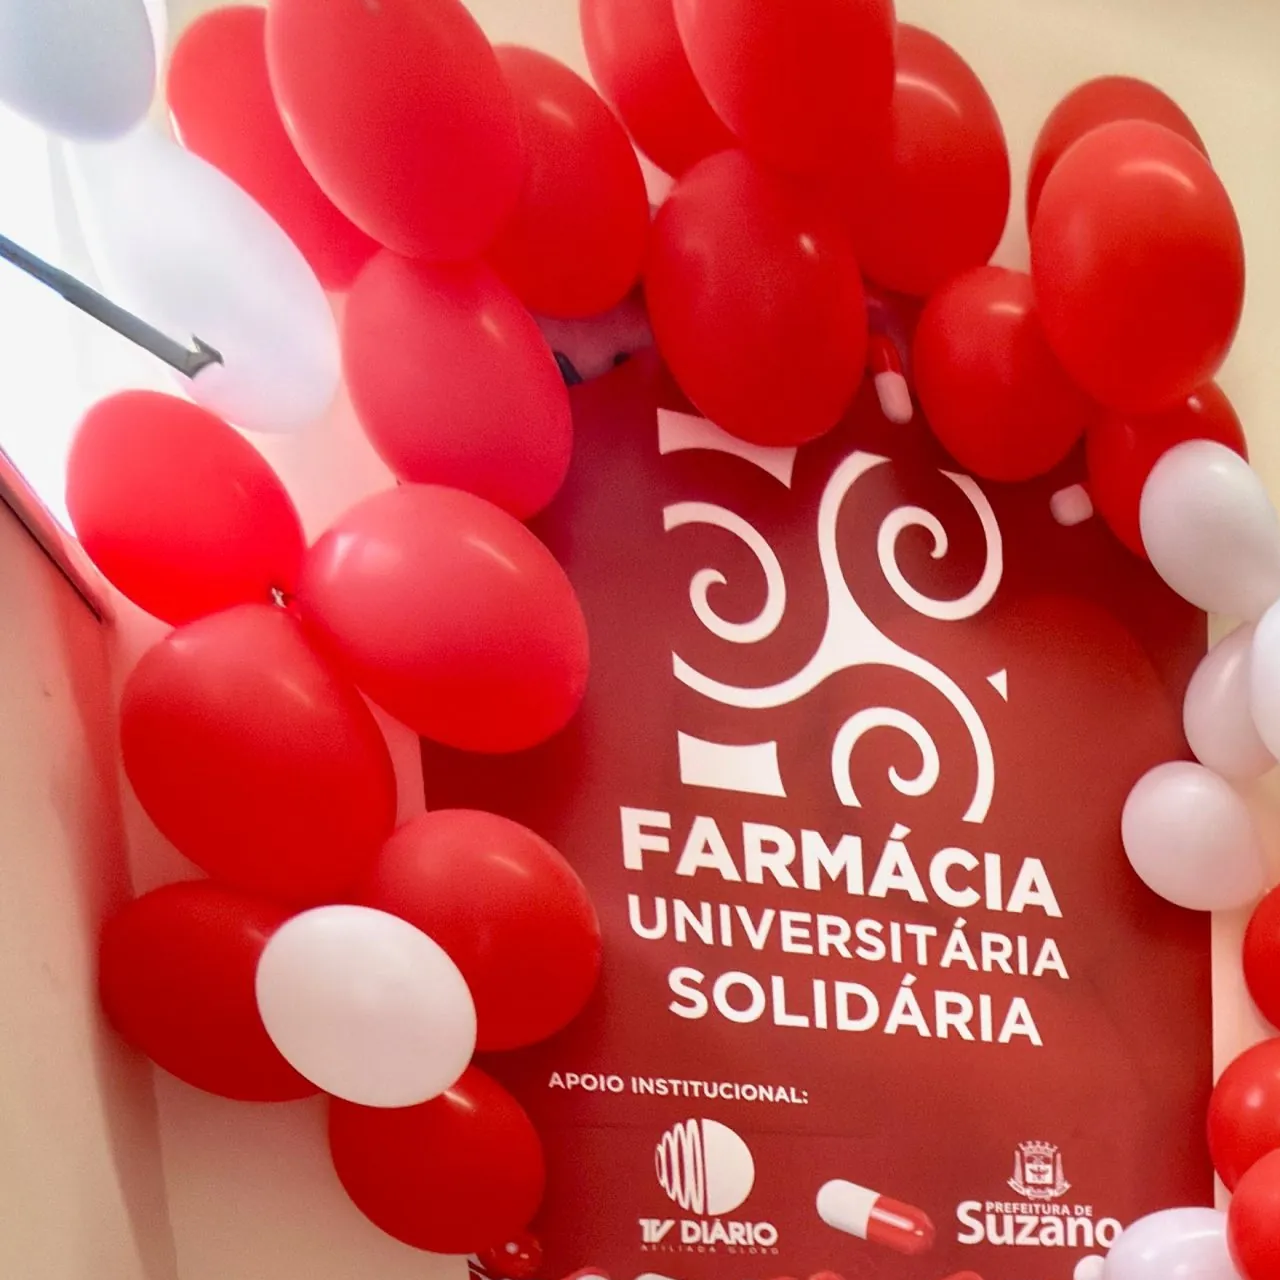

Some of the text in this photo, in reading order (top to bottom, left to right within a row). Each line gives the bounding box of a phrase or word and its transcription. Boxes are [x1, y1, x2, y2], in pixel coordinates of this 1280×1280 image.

[619, 805, 1063, 917] FARMÁCIA
[627, 894, 1070, 979] UNIVERSITÁRIA
[667, 965, 1044, 1047] SOLIDÁRIA
[548, 1071, 809, 1105] APOIO INSTITUCIONAL:
[638, 1218, 779, 1247] TV DIÁRIO
[956, 1200, 1123, 1249] Suzano
[985, 1201, 1093, 1217] PREFEITURA DE
